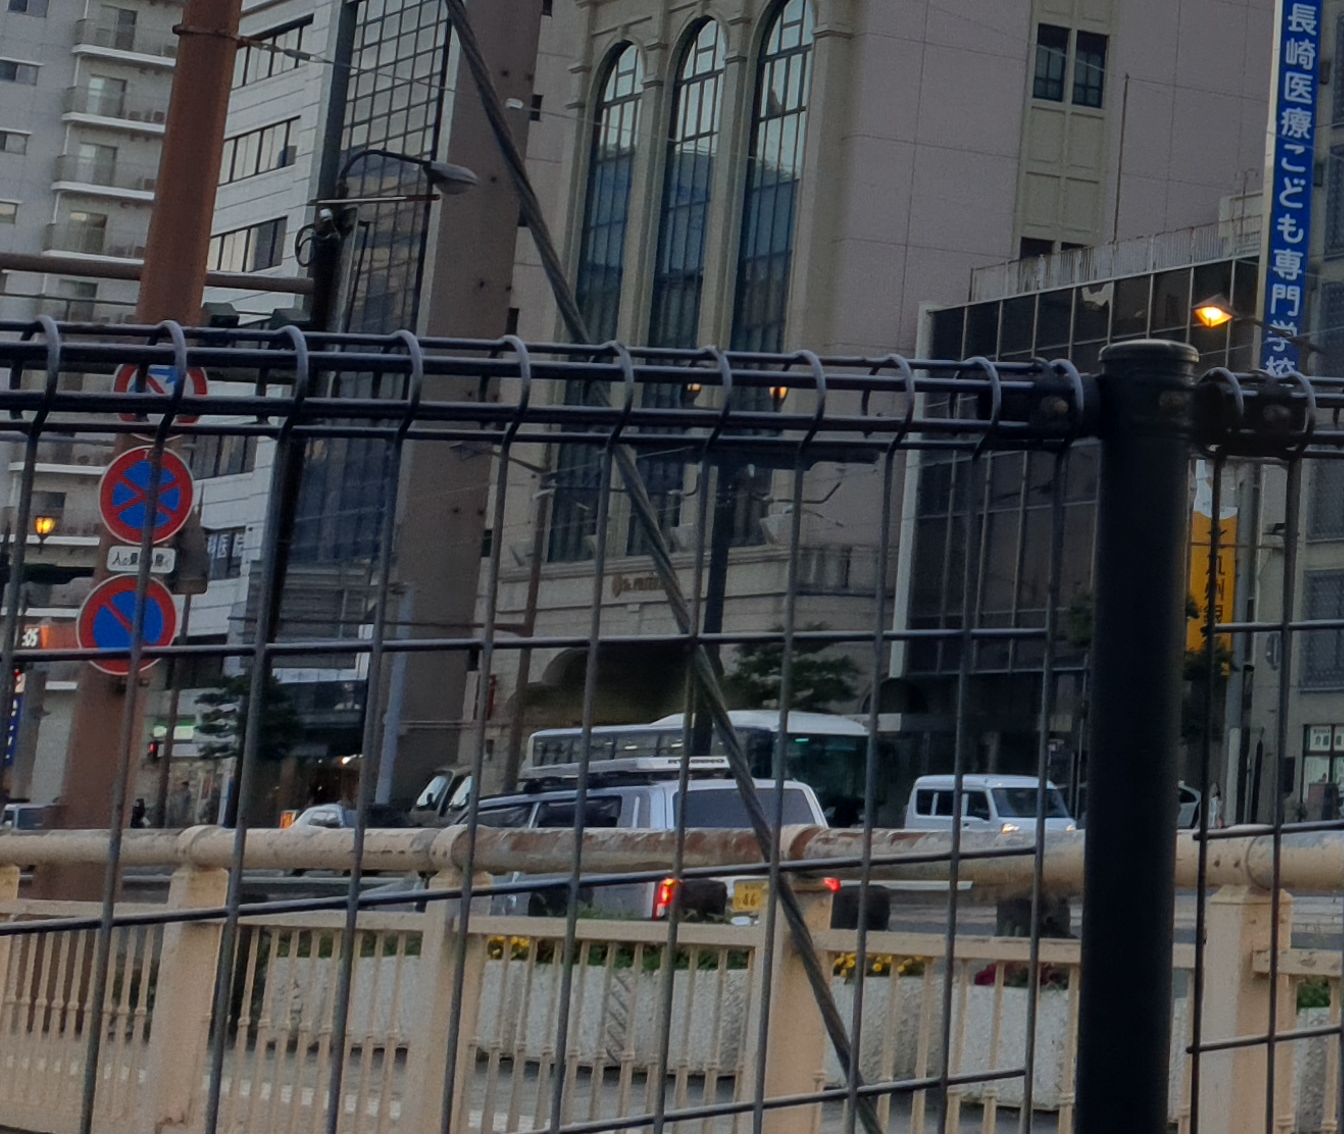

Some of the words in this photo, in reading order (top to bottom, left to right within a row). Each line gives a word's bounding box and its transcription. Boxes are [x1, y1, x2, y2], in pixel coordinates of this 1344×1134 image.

[1264, 2, 1318, 377] 長崎医療こども専門学校
